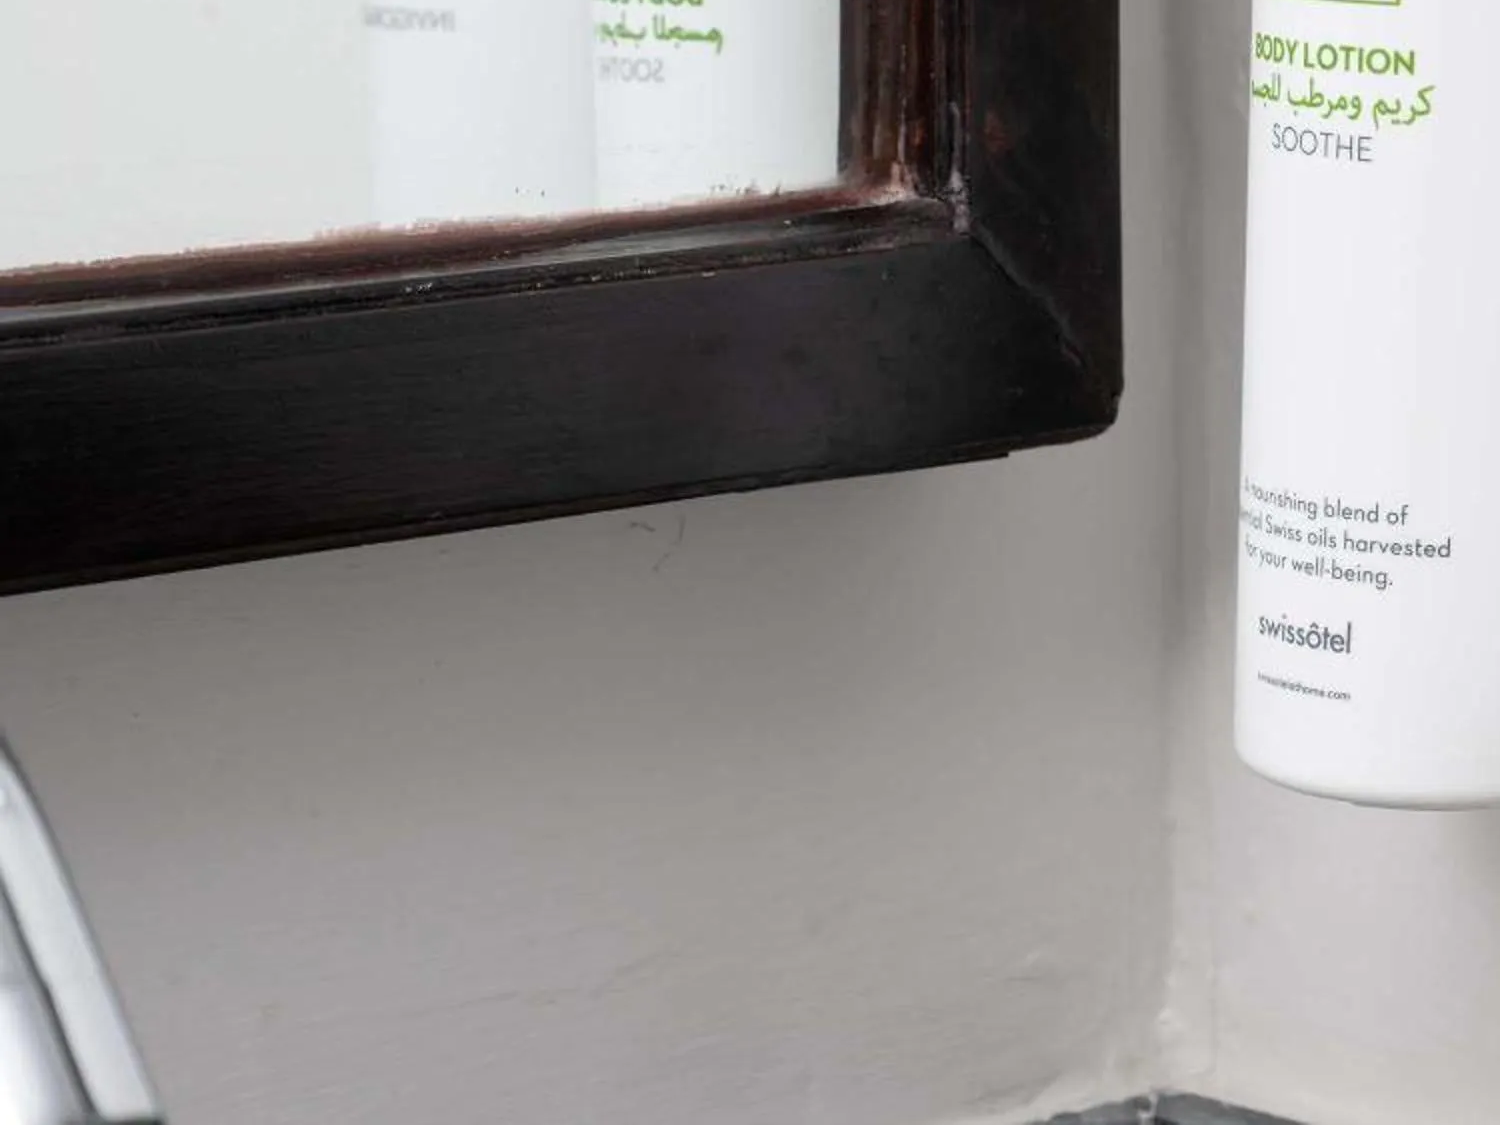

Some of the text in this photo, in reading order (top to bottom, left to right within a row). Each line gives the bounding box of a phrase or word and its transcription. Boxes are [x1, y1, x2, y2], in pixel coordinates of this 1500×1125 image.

[1255, 31, 1416, 75] BODY LOTION
[1272, 122, 1374, 162] SOOTHE
[1323, 497, 1379, 523] blend
[1386, 505, 1409, 525] of
[1265, 514, 1303, 543] Swiss
[1307, 527, 1337, 549] oils
[1343, 530, 1451, 558] harvested
[1259, 546, 1287, 570] your
[1291, 556, 1393, 590] well-being.
[1258, 613, 1352, 654] swissôtel
